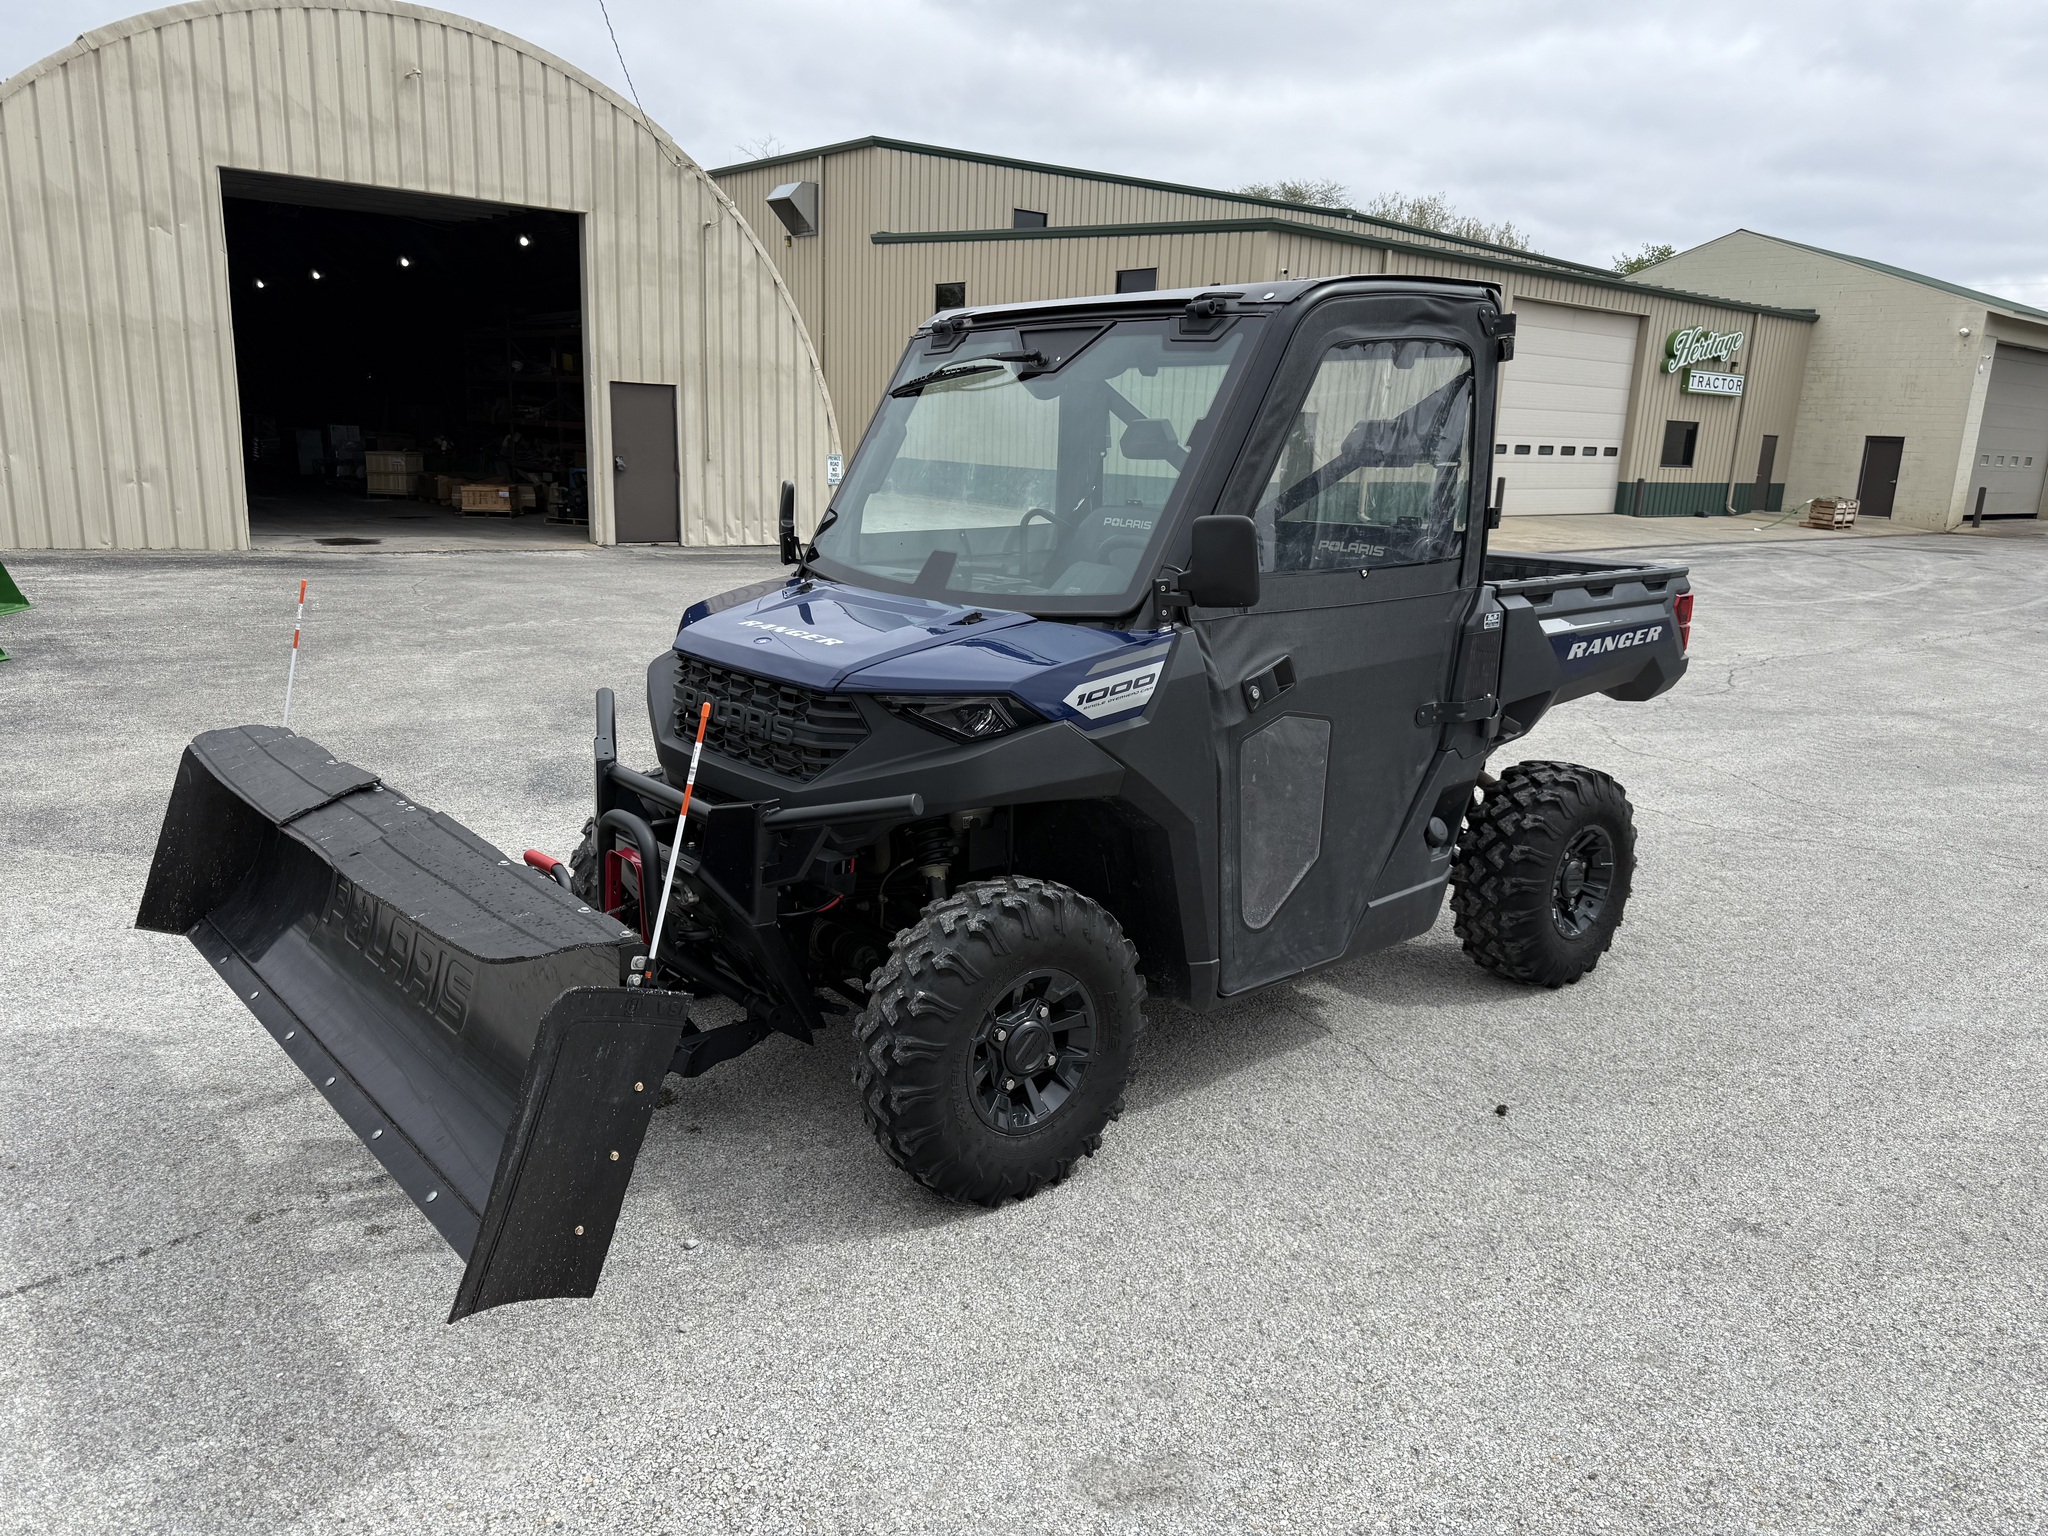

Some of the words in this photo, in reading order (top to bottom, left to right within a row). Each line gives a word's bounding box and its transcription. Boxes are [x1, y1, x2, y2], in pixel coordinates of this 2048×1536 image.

[1668, 326, 1744, 373] Heritage
[1690, 375, 1742, 391] TRACTOR
[1103, 517, 1152, 530] POLARIS
[1318, 540, 1385, 557] POLARIS
[737, 620, 845, 646] RANGER
[1566, 625, 1663, 660] RANGER
[1077, 673, 1155, 706] 1000
[322, 876, 475, 1036] POLARIS
